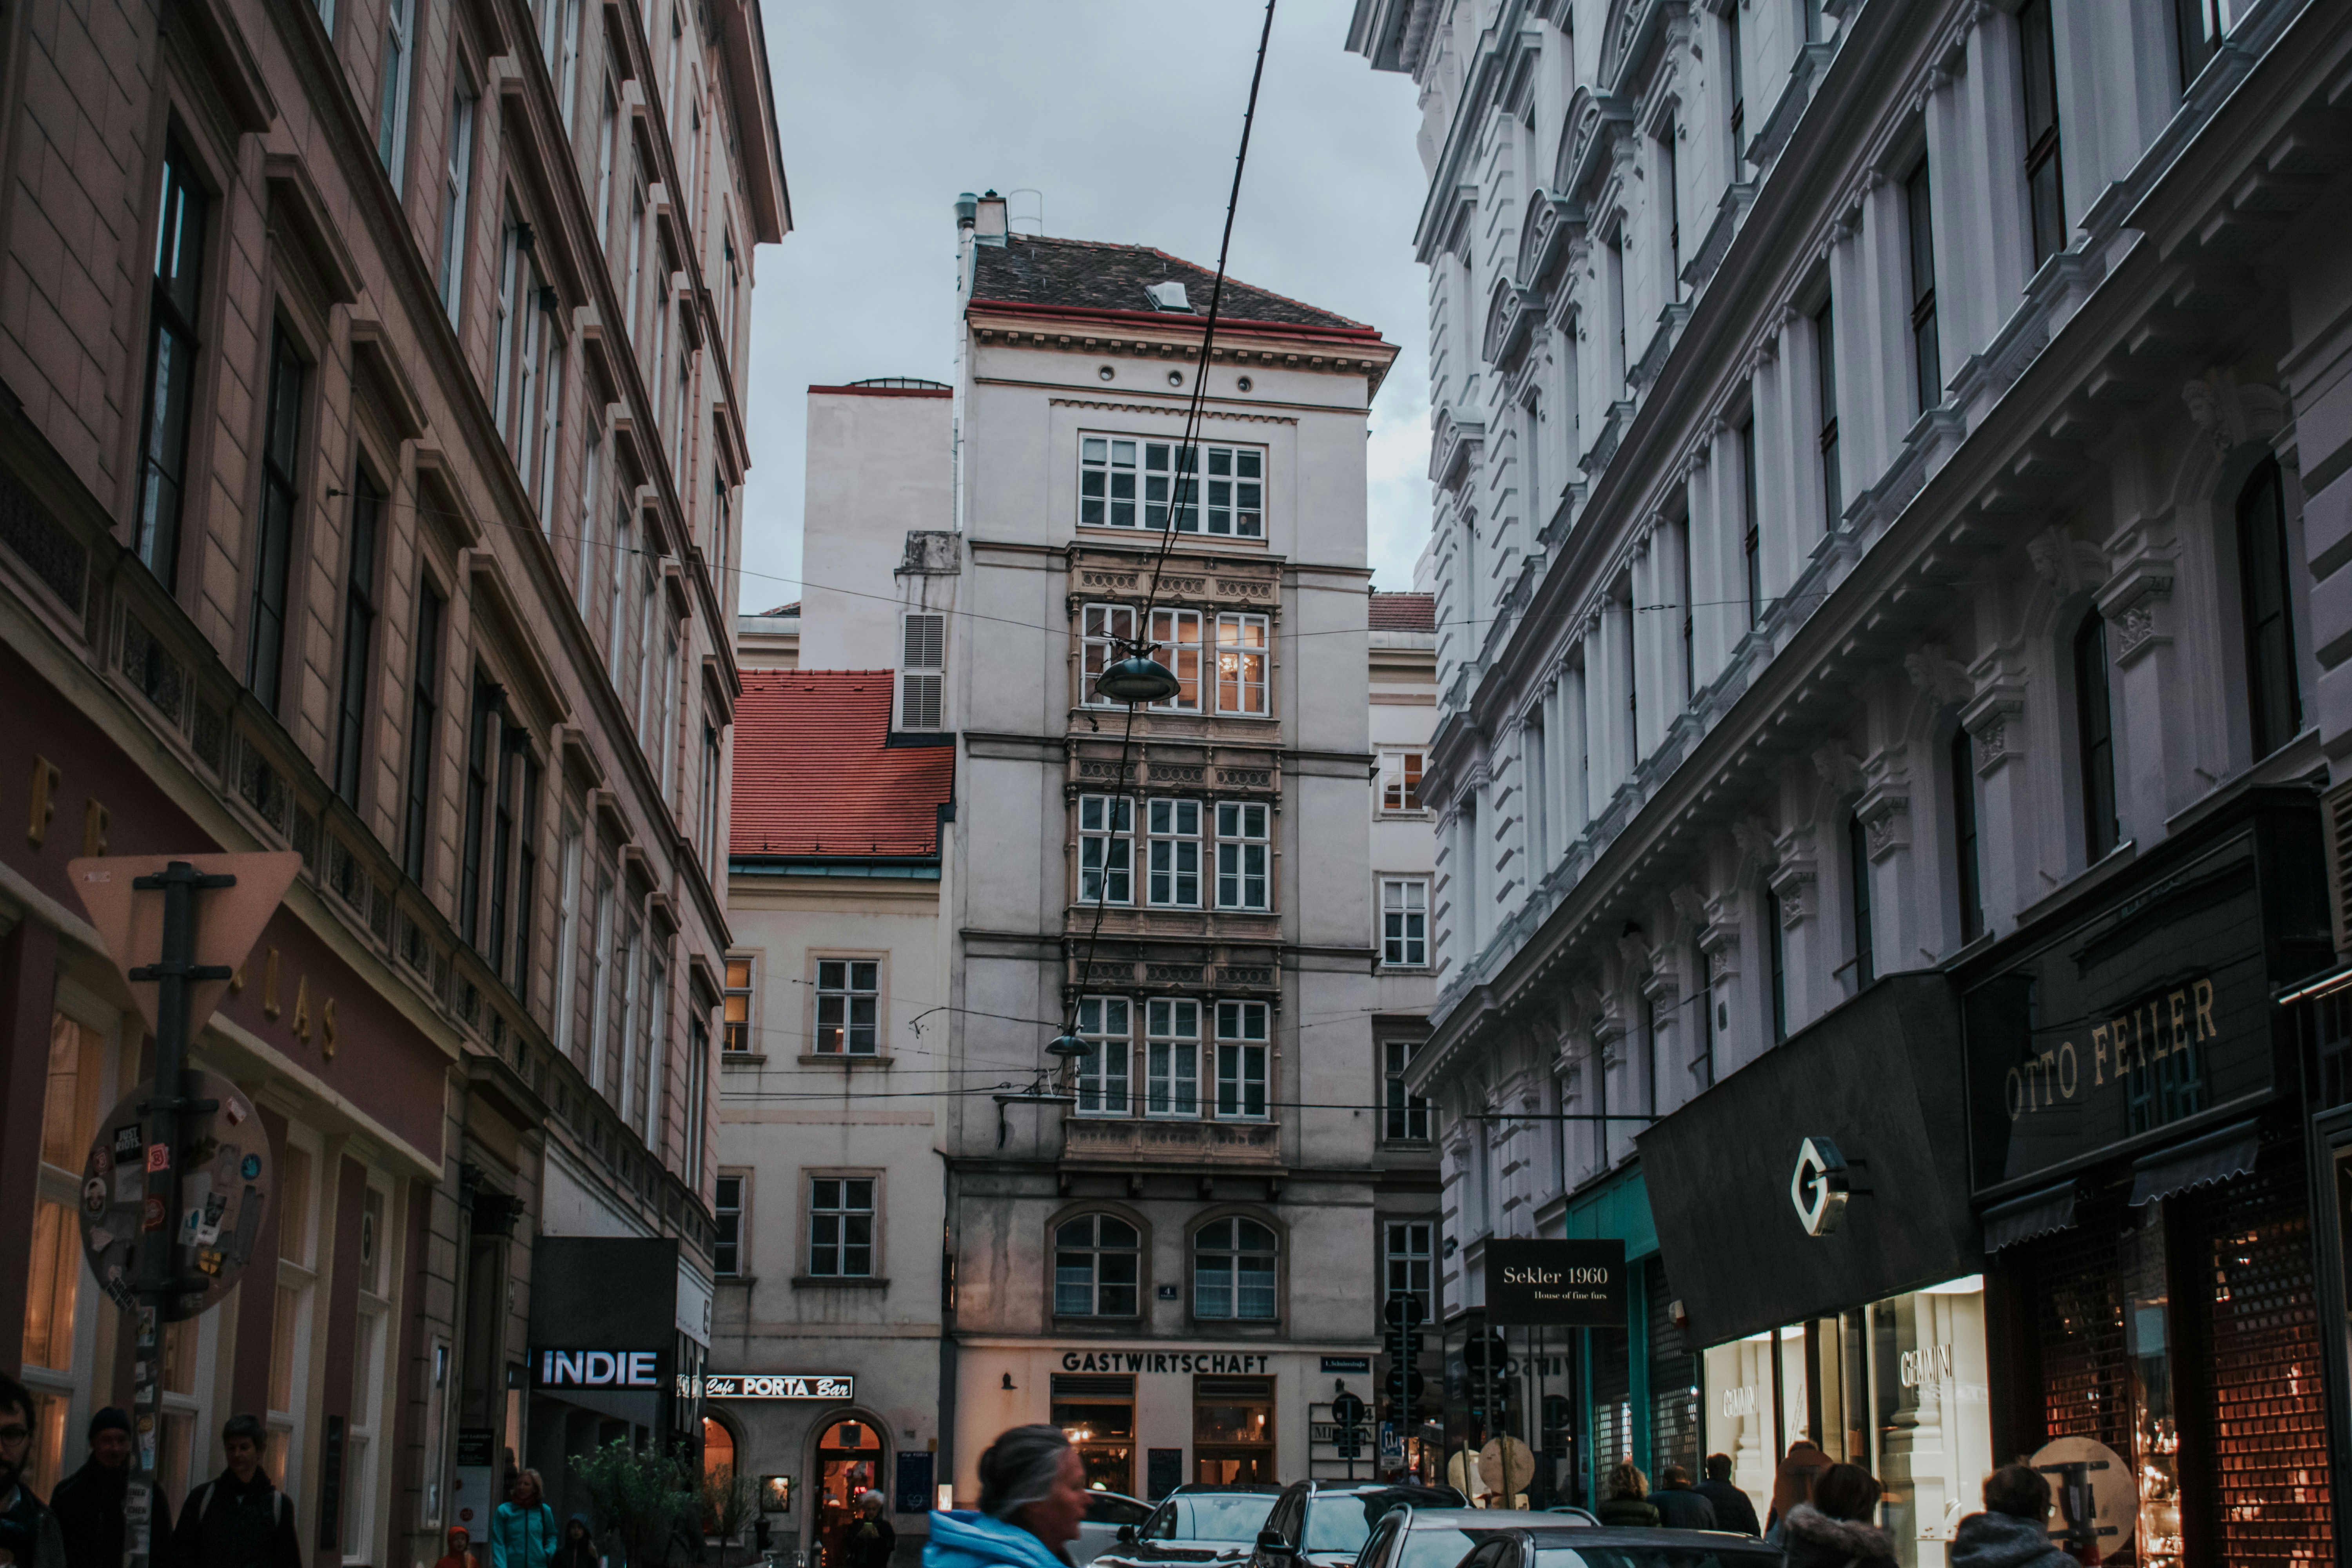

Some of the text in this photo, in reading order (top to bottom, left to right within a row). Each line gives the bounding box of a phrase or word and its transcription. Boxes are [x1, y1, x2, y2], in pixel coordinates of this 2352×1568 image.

[2005, 978, 2217, 1121] OTTO FEILER
[119, 1127, 138, 1141] JUST
[1791, 1137, 1842, 1236] G
[1503, 1267, 1608, 1284] Sekler 1960
[1534, 1291, 1607, 1299] House of fine furs
[543, 1350, 657, 1385] INDIE
[1062, 1352, 1268, 1374] GASTWIRTSCHAFT
[1901, 1344, 1953, 1388] GEMMINI
[706, 1378, 848, 1396] Cafe PORTA Bar
